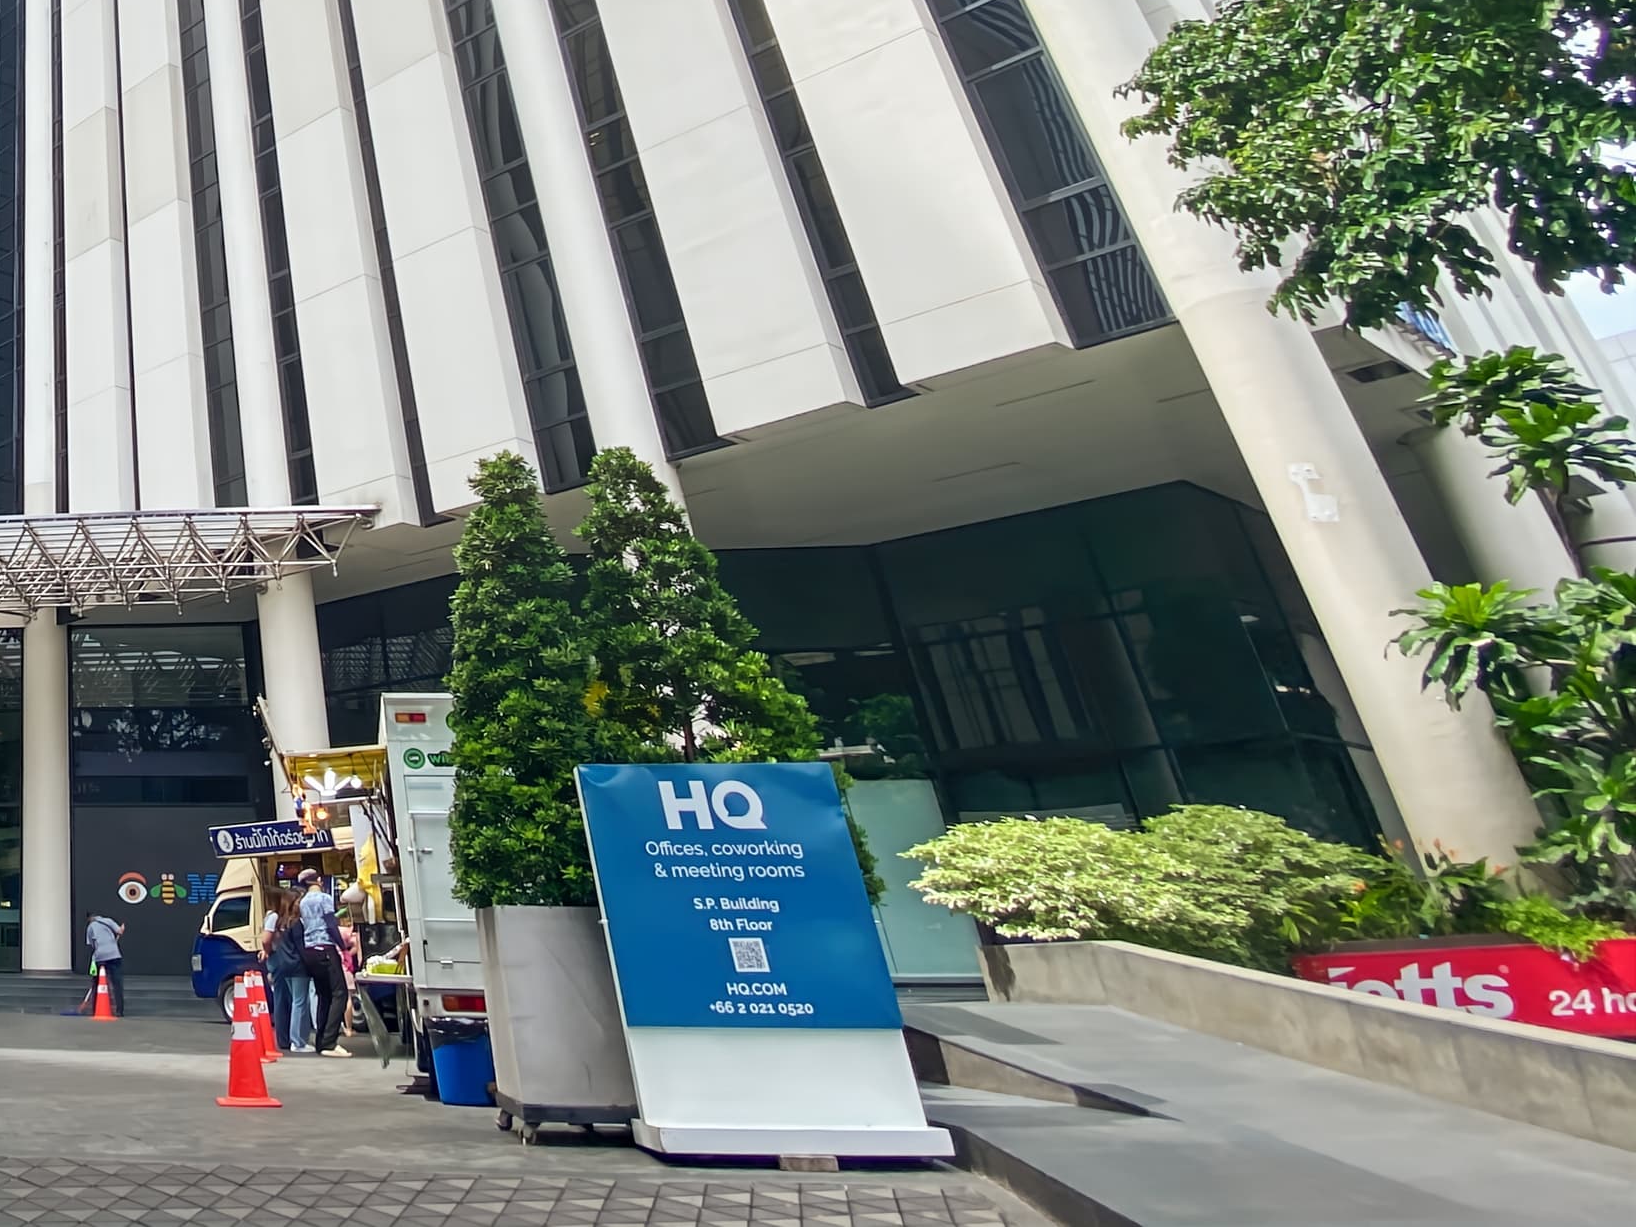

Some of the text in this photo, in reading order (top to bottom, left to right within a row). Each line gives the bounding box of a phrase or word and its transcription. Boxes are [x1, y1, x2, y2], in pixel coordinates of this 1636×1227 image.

[658, 780, 768, 830] HQ
[645, 840, 804, 859] Offices, coworking
[654, 862, 805, 882] & meeting rooms
[693, 897, 780, 913] S.P. Building
[709, 918, 773, 931] 8th Floor
[726, 982, 788, 996] HQ.COM
[709, 1000, 814, 1017] +66 2 021 0520
[1548, 988, 1595, 1017] 24
